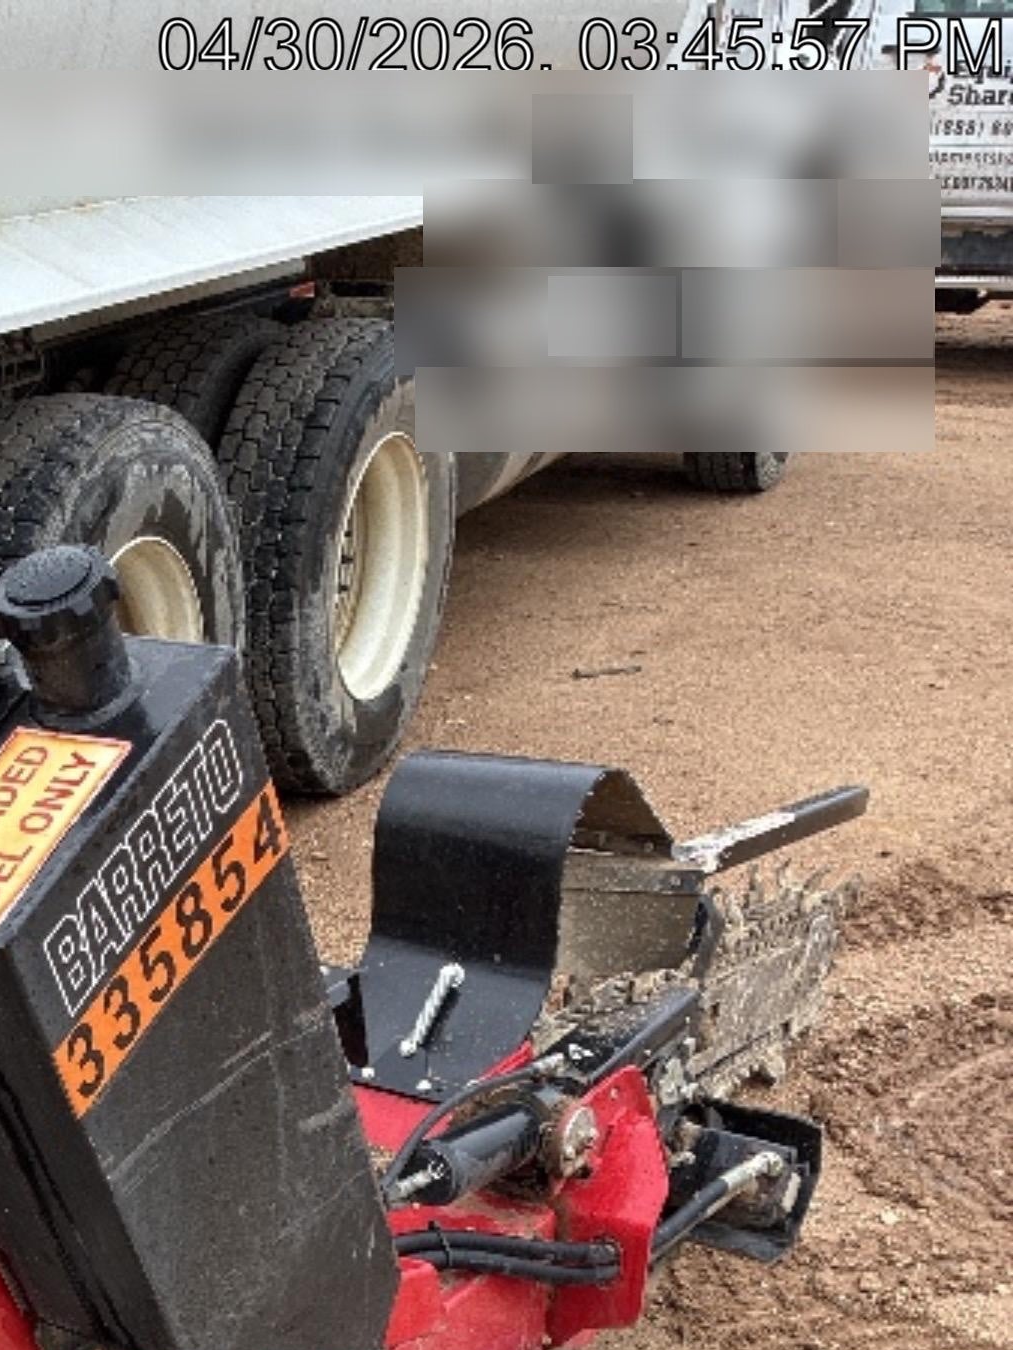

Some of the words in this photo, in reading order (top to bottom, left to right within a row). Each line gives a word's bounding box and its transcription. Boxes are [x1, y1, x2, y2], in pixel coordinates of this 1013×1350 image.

[946, 83, 1013, 106] Shar
[19, 750, 97, 836] ONLY
[43, 718, 244, 1018] BARRETO
[66, 793, 284, 1098] 335854
